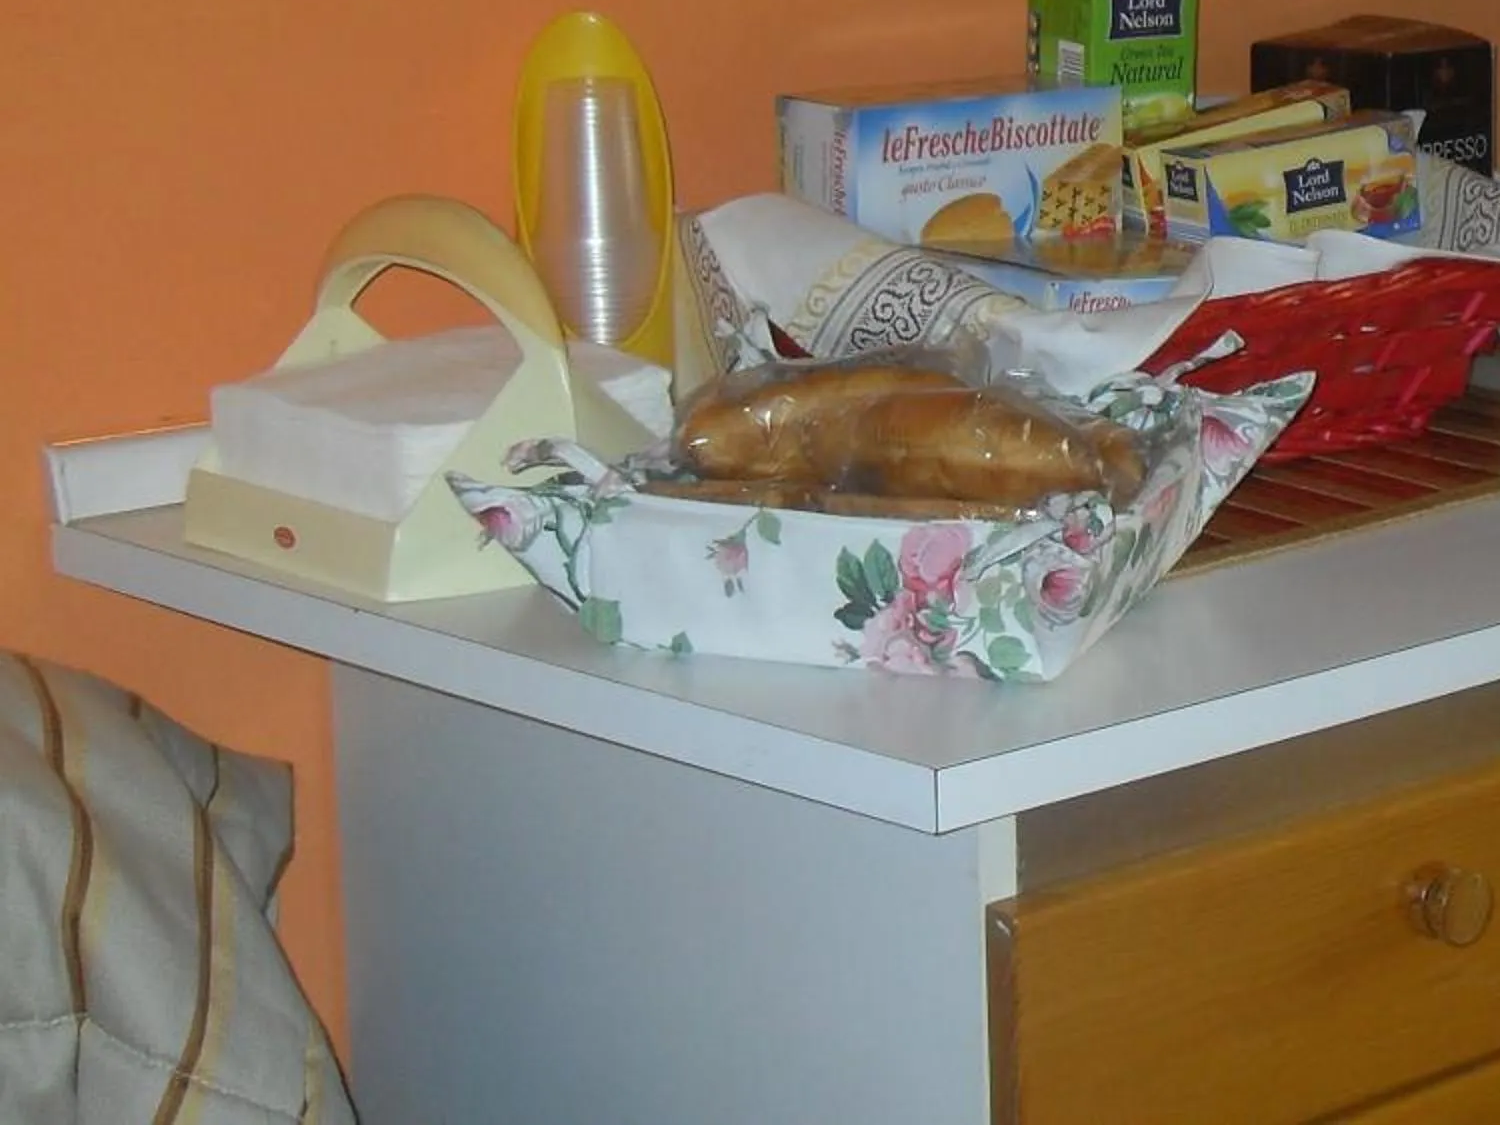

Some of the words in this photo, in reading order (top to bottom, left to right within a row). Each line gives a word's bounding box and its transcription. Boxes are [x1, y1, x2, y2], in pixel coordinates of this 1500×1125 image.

[1119, 11, 1174, 31] Nelson
[1110, 56, 1185, 86] Natural
[882, 112, 1101, 164] leFrescheBiscottate
[1416, 133, 1487, 161] PRESSO
[1298, 168, 1330, 189] Lord
[1291, 184, 1340, 208] Nelson
